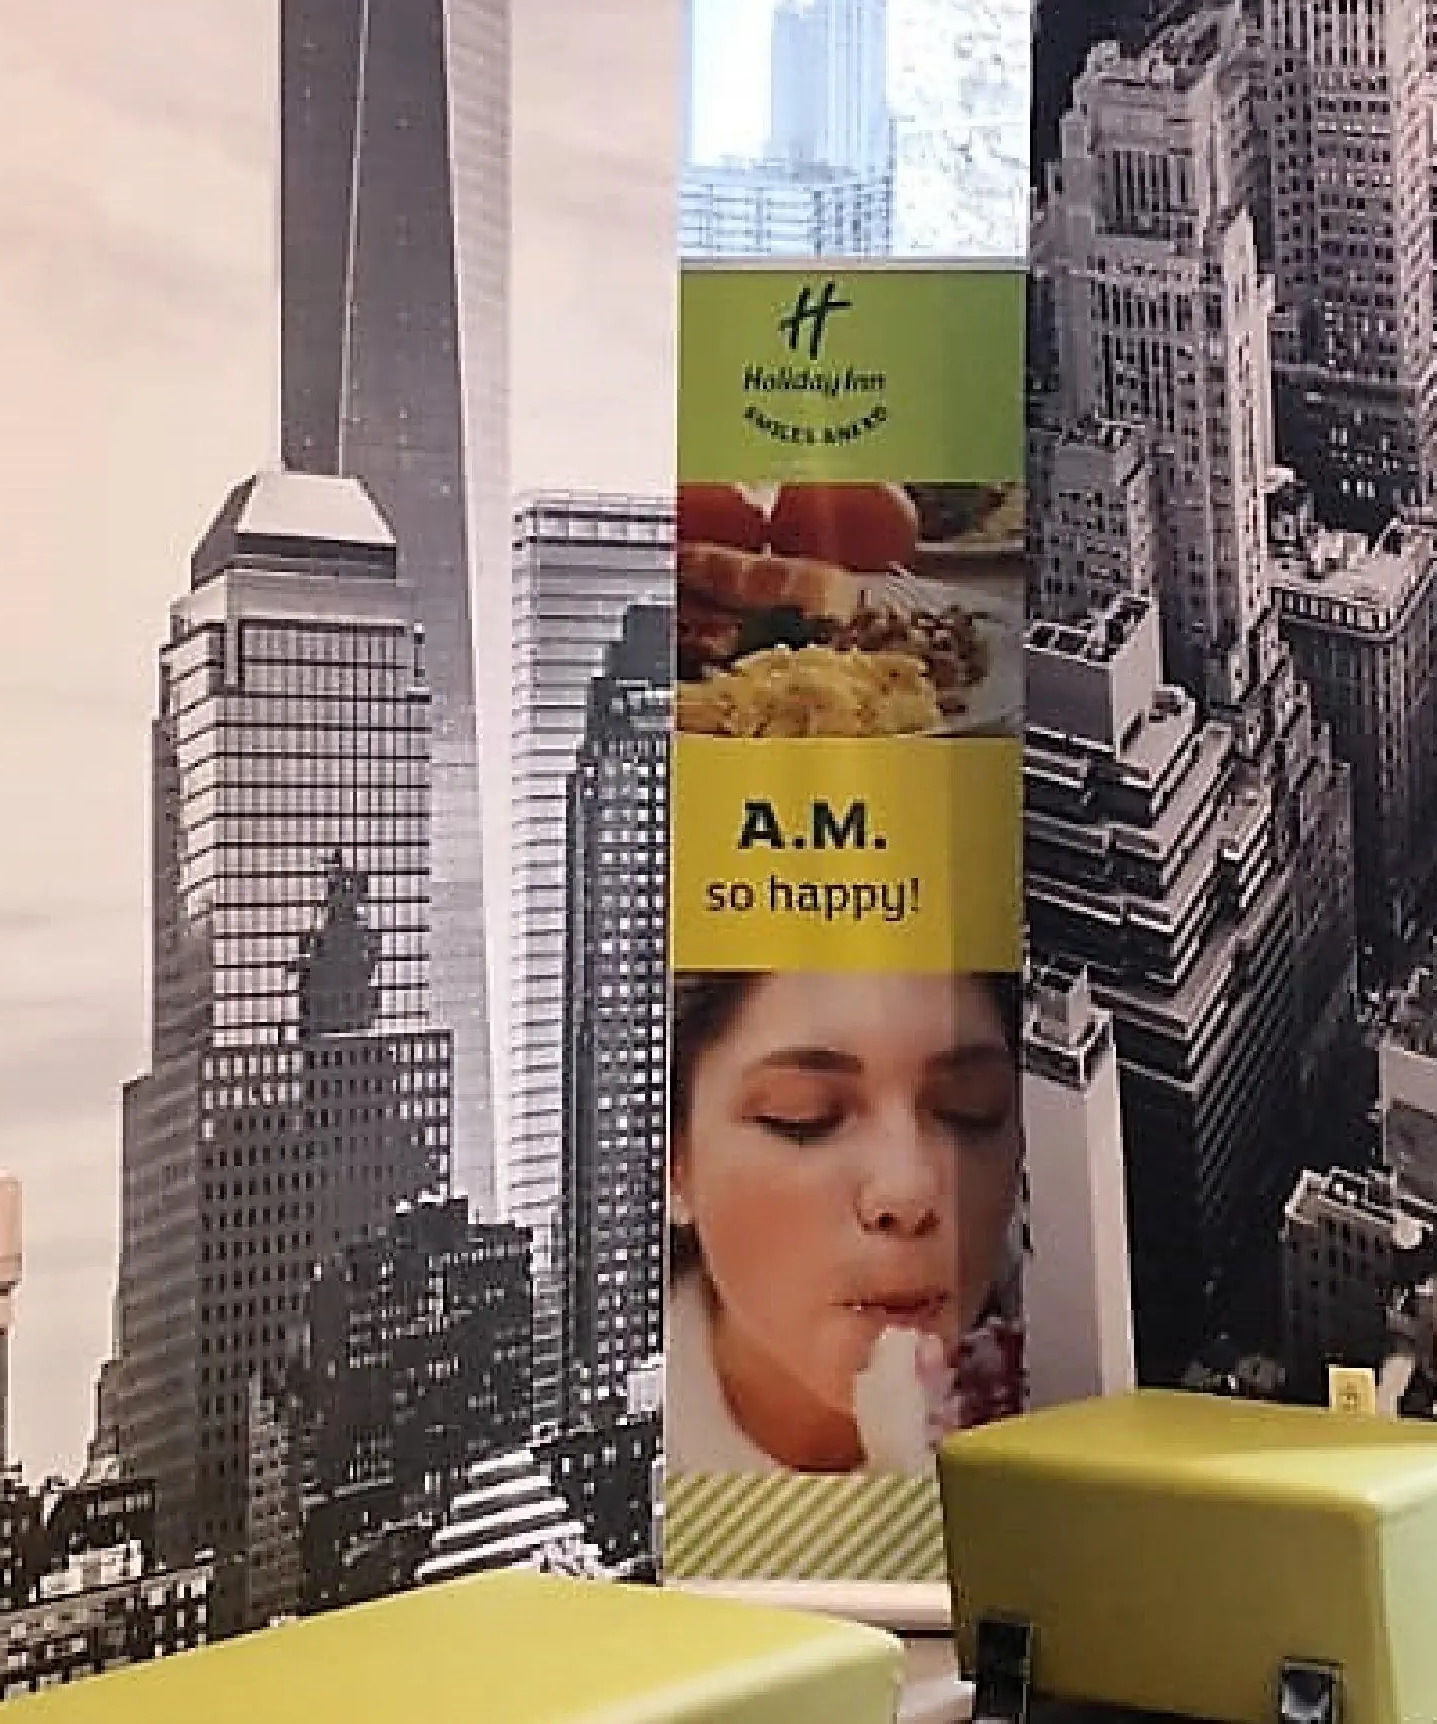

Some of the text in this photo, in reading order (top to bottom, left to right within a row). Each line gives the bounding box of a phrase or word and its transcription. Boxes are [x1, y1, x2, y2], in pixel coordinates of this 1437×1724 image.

[742, 364, 887, 397] Holiday Inn
[738, 798, 887, 850] A.M.
[705, 875, 919, 922] so happy!
